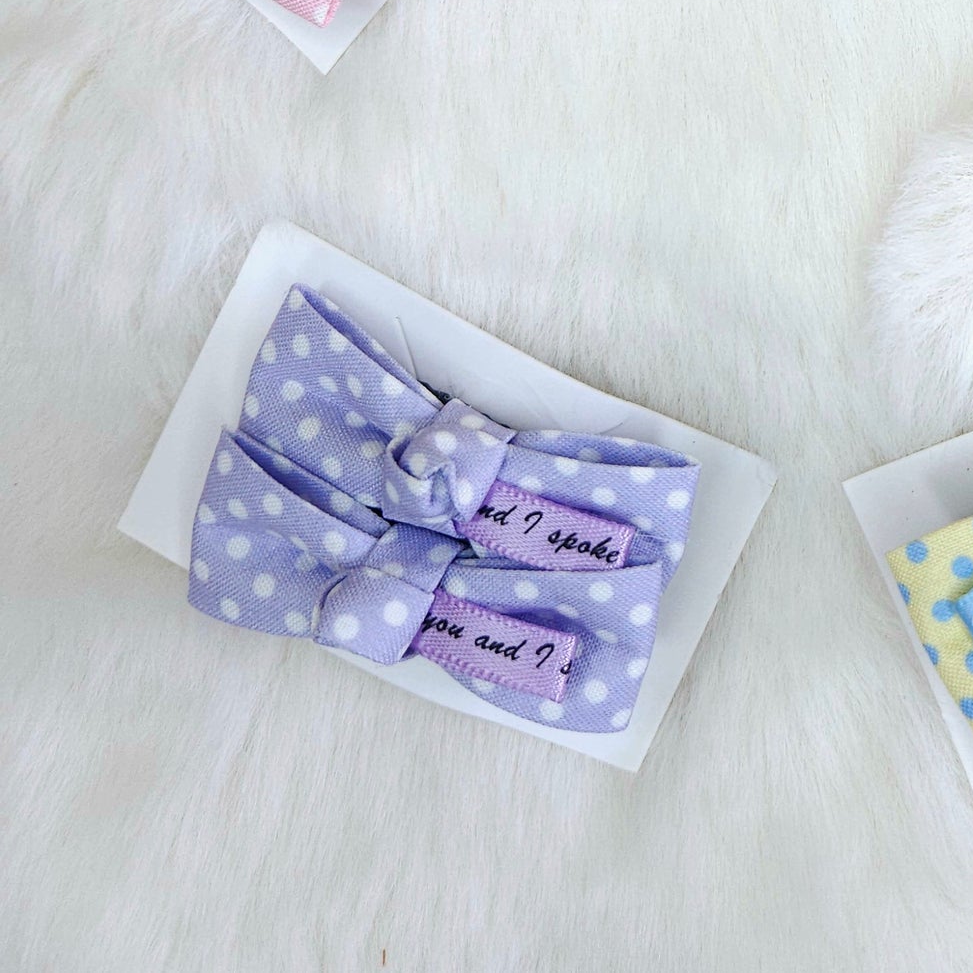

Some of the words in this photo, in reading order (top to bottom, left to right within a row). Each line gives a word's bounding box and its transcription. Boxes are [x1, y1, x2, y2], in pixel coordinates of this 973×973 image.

[523, 510, 544, 535] I
[547, 528, 620, 564] spoke
[421, 612, 466, 639] you
[474, 634, 528, 661] and
[534, 642, 556, 669] I
